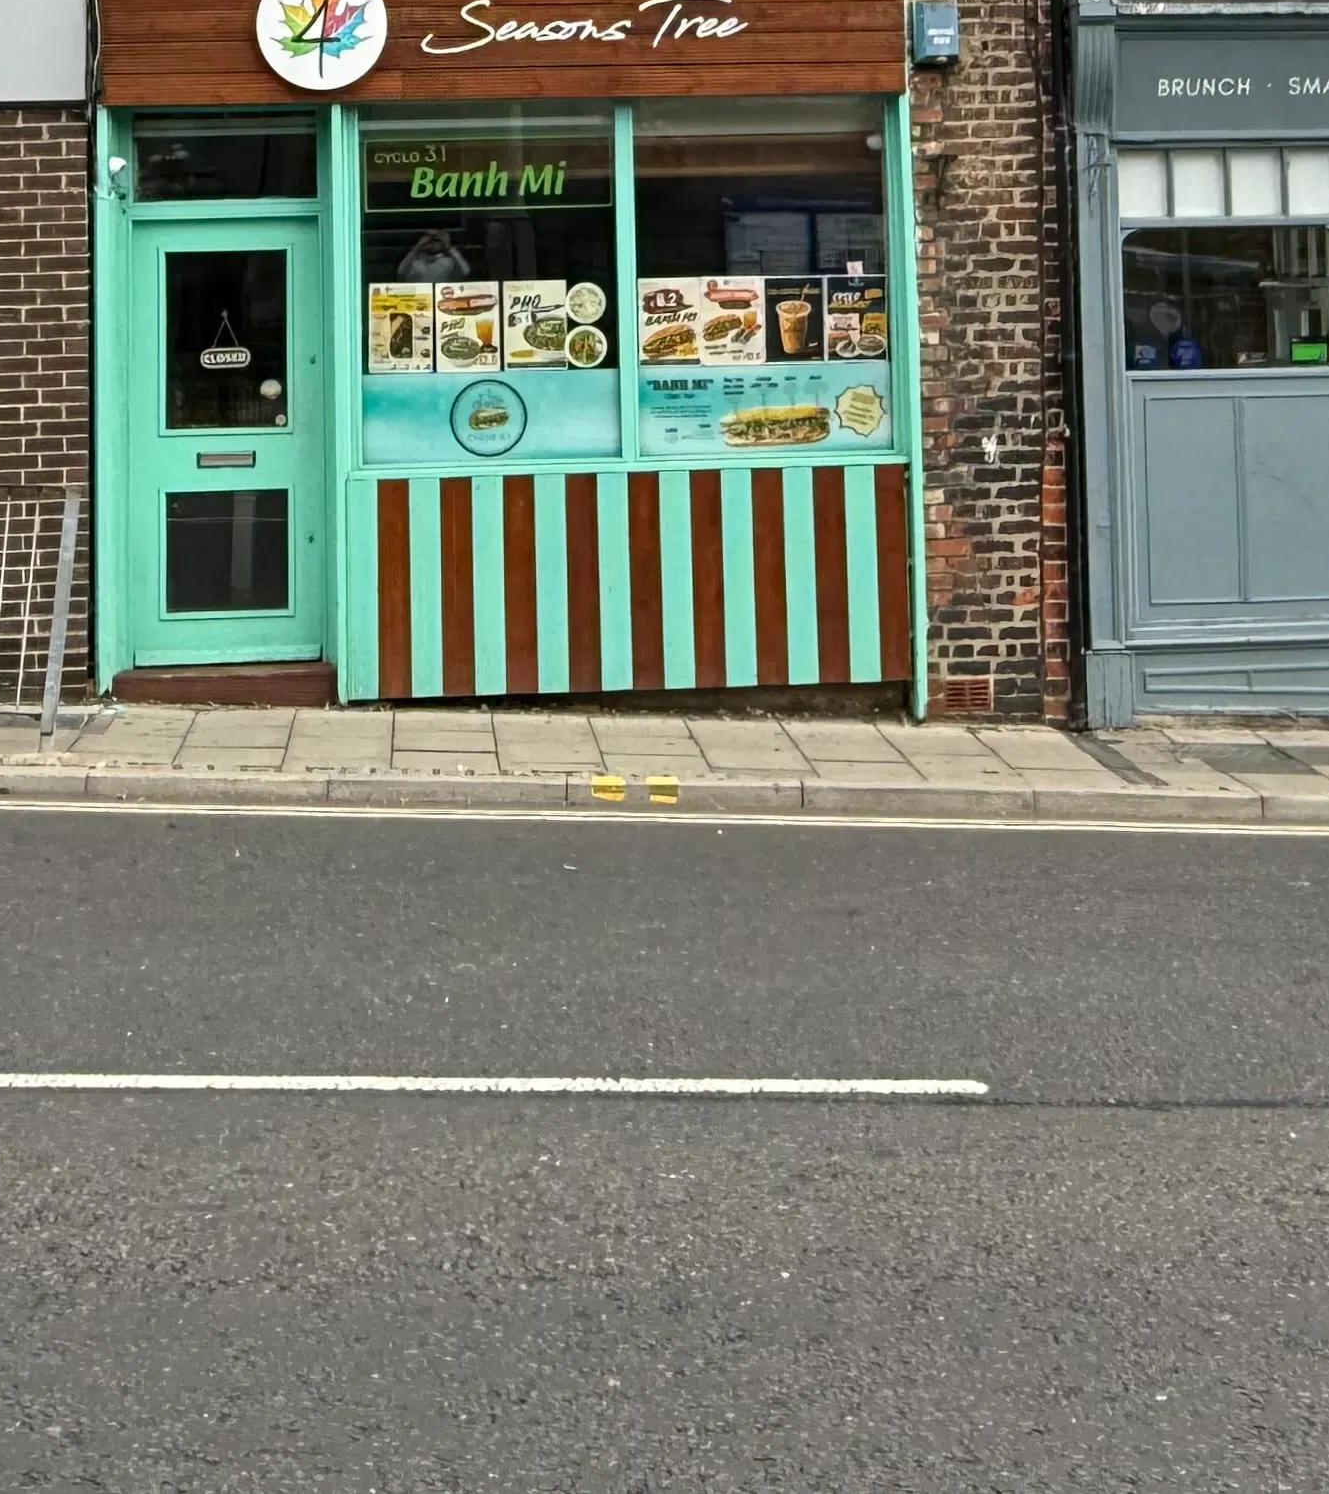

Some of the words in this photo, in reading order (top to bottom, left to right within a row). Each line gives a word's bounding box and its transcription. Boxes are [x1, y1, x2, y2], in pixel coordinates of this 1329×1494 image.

[1157, 77, 1251, 97] BRUNCH
[410, 161, 509, 198] Banh
[519, 160, 567, 196] Mi
